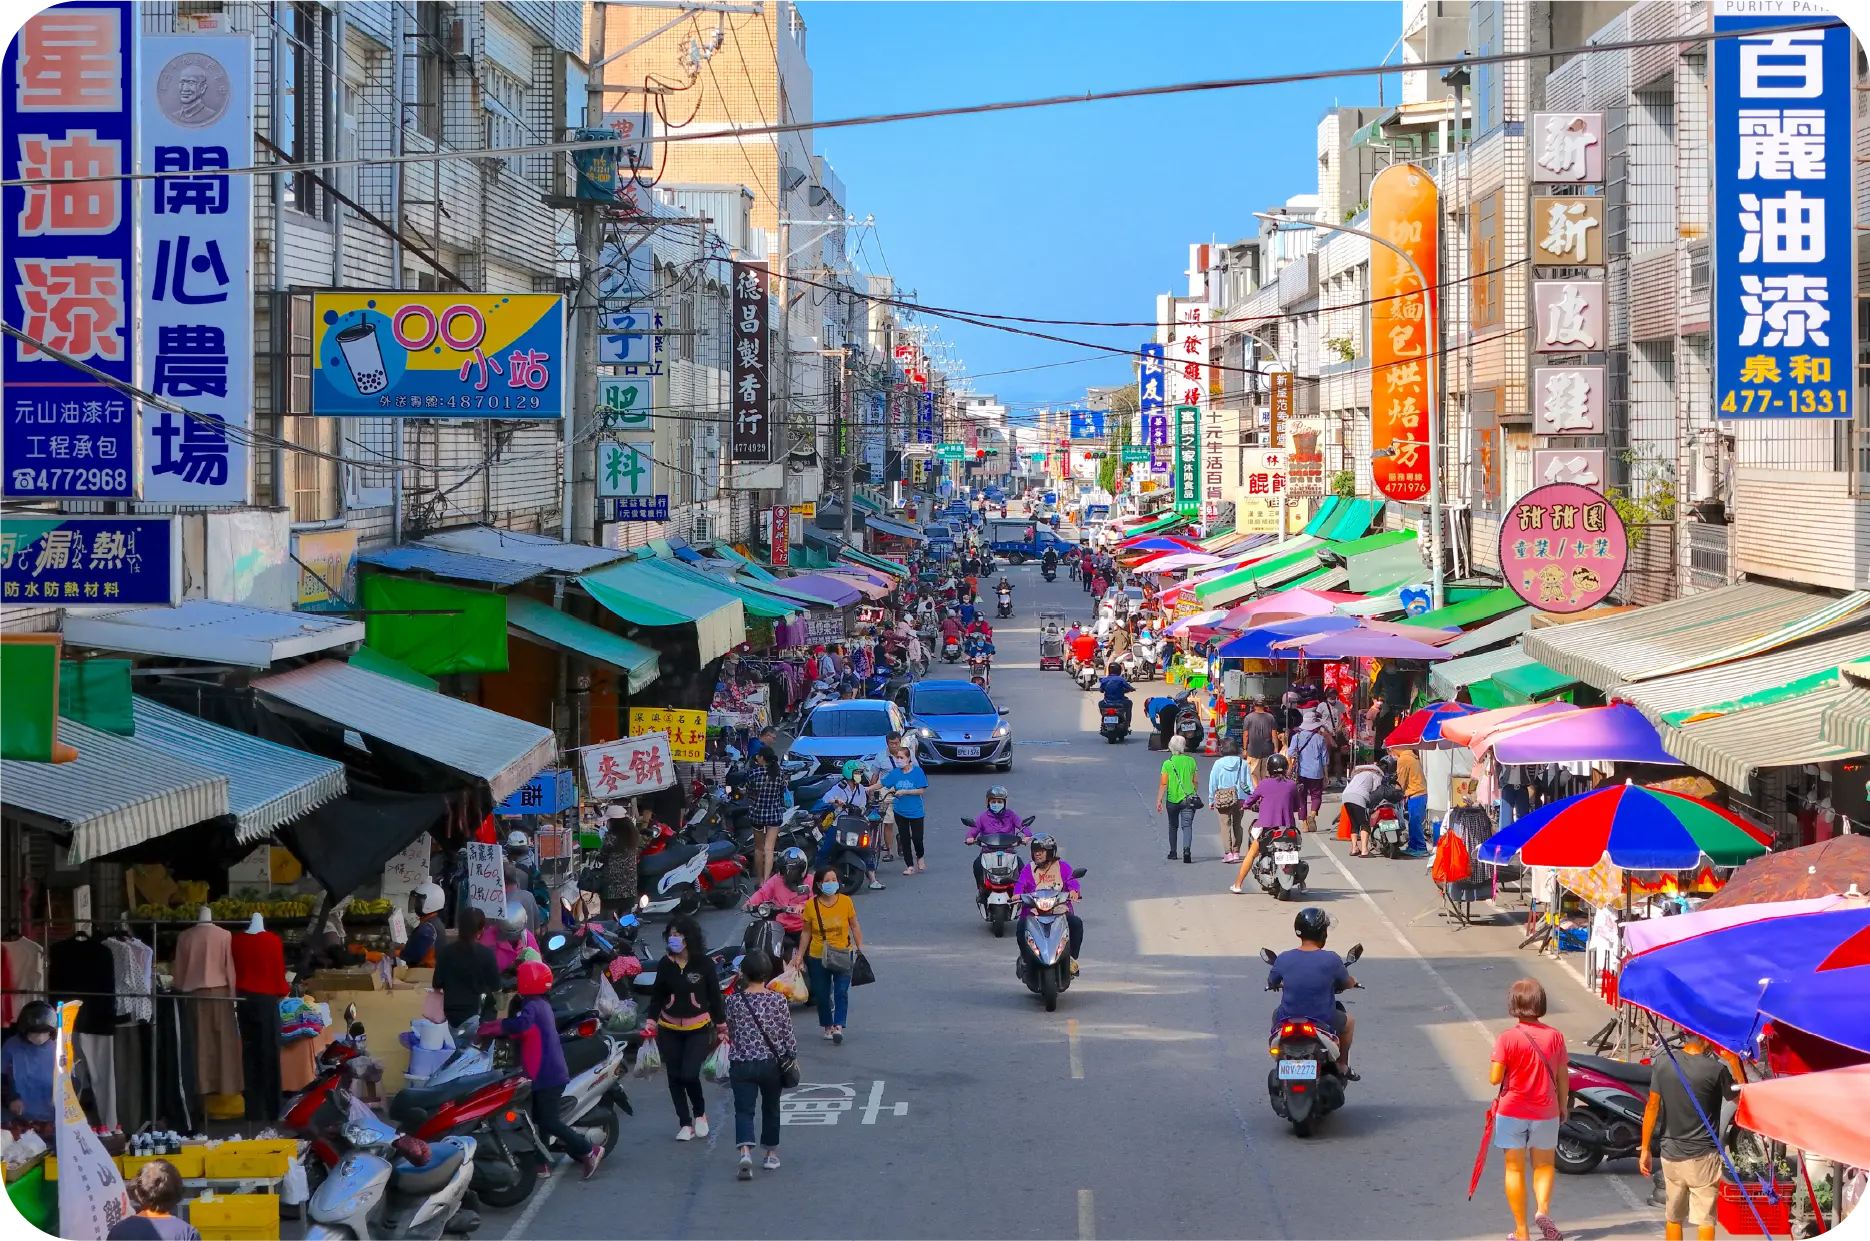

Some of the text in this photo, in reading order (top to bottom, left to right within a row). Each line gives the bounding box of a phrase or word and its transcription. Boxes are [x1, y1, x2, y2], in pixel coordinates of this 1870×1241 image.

[16, 8, 124, 361] 星油漆
[1738, 29, 1829, 347] 百麗油漆
[152, 146, 230, 486] 開心農場
[735, 270, 763, 435] 德昌製香行
[459, 347, 550, 391] 小站
[1739, 354, 1832, 383] 泉和
[14, 400, 125, 424] 元山油漆行
[1720, 389, 1848, 413] 477-1331
[25, 435, 118, 459] 工程承包
[733, 443, 767, 453] 4774929
[1206, 411, 1223, 500] 十元生活百貨
[1266, 455, 1280, 467] 林
[37, 468, 127, 491] 4772968
[1384, 482, 1427, 493] 4771976
[1516, 501, 1606, 532] 甜甜圈
[4, 581, 120, 598] 防水防熱材料
[596, 746, 665, 793] 麥餅
